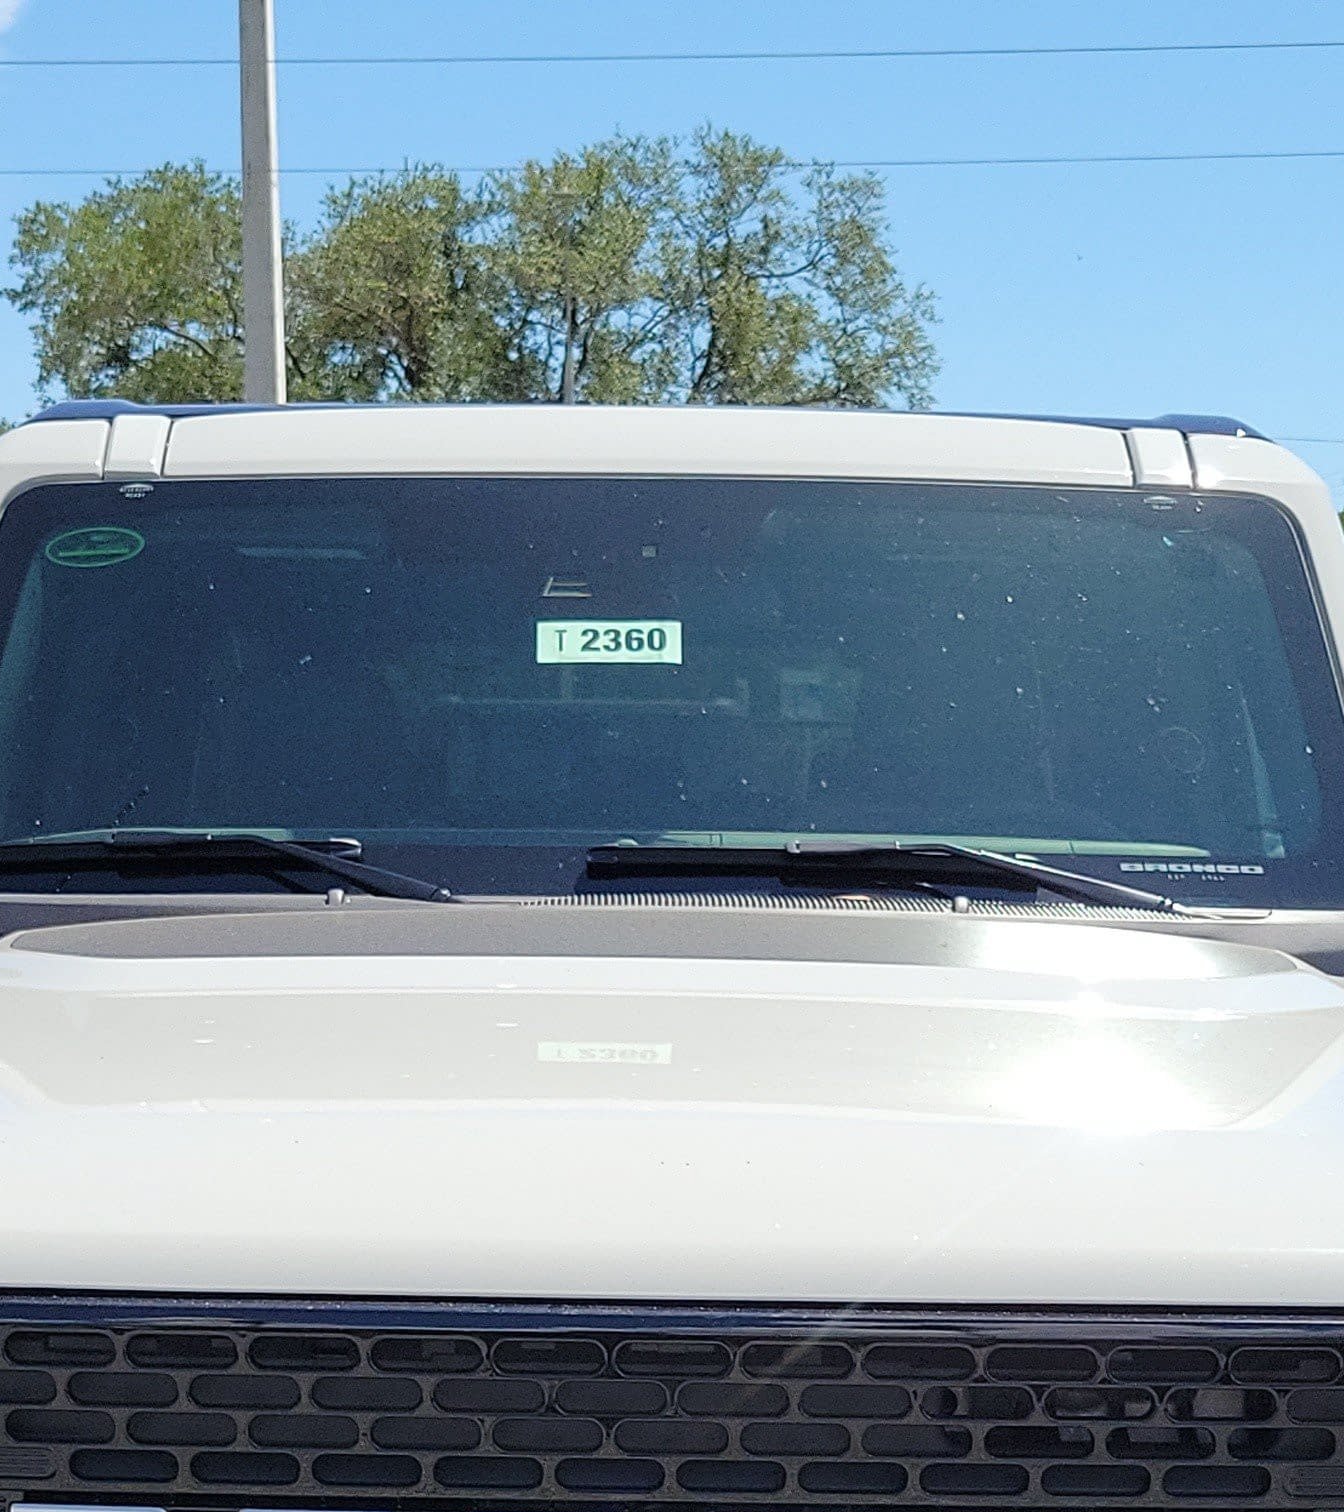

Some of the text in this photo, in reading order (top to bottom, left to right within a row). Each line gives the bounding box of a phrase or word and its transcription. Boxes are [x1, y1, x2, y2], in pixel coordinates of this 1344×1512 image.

[554, 628, 667, 652] T 2360
[1119, 862, 1265, 875] BRONCO
